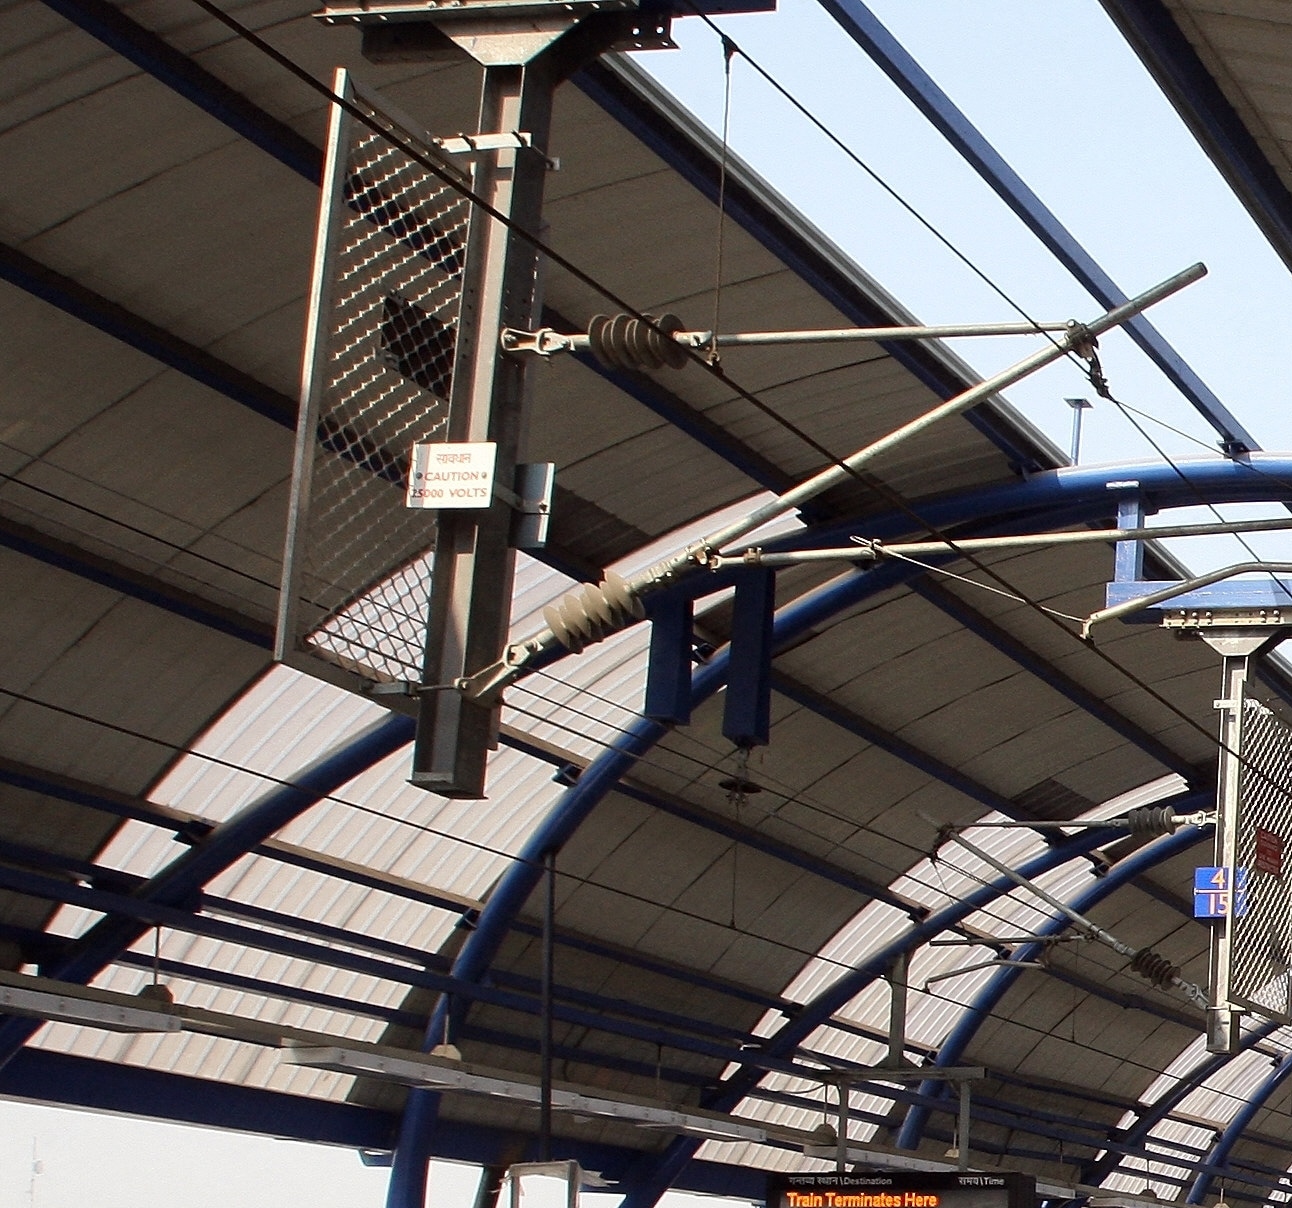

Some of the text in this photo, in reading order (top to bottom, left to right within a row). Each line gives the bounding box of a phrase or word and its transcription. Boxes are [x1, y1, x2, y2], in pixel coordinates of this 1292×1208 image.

[424, 471, 479, 481] CAUTION
[412, 487, 488, 498] 25000 VOLTS
[1210, 868, 1226, 890] 4
[786, 1192, 938, 1208] Train Terminates Here
